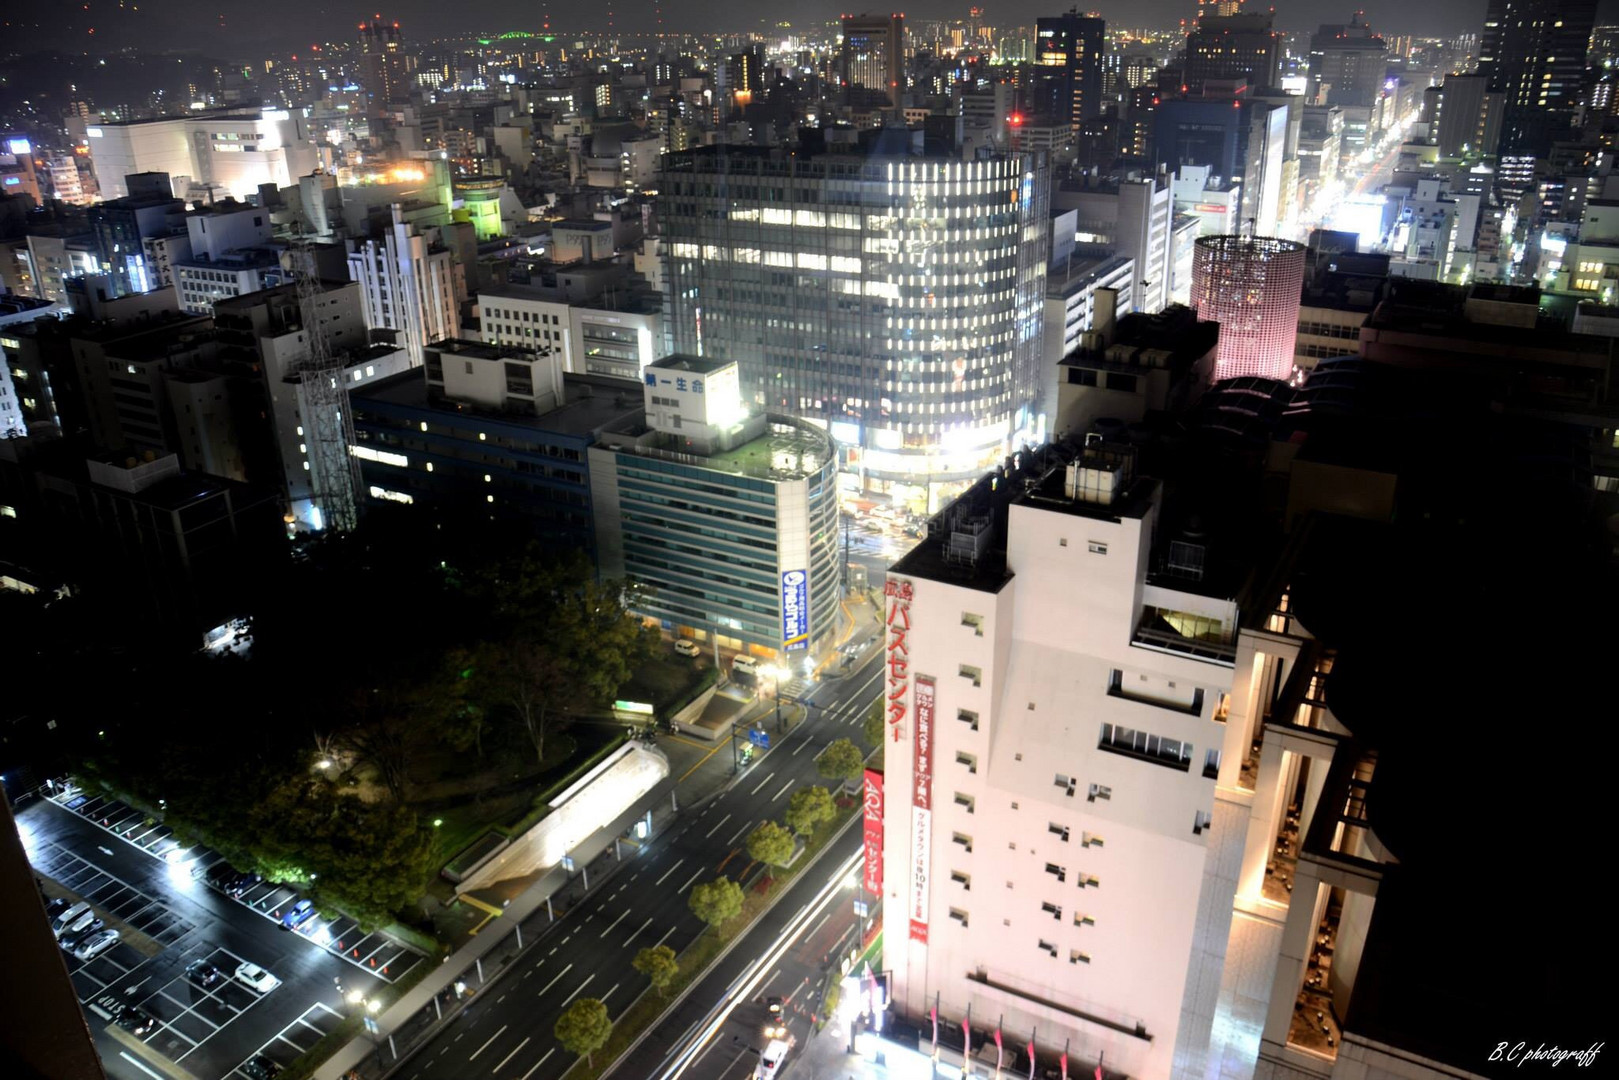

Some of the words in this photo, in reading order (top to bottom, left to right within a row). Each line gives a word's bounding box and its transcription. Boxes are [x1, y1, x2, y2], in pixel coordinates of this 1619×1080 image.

[645, 373, 703, 394] 第一生命
[97, 995, 127, 1014] STOP
